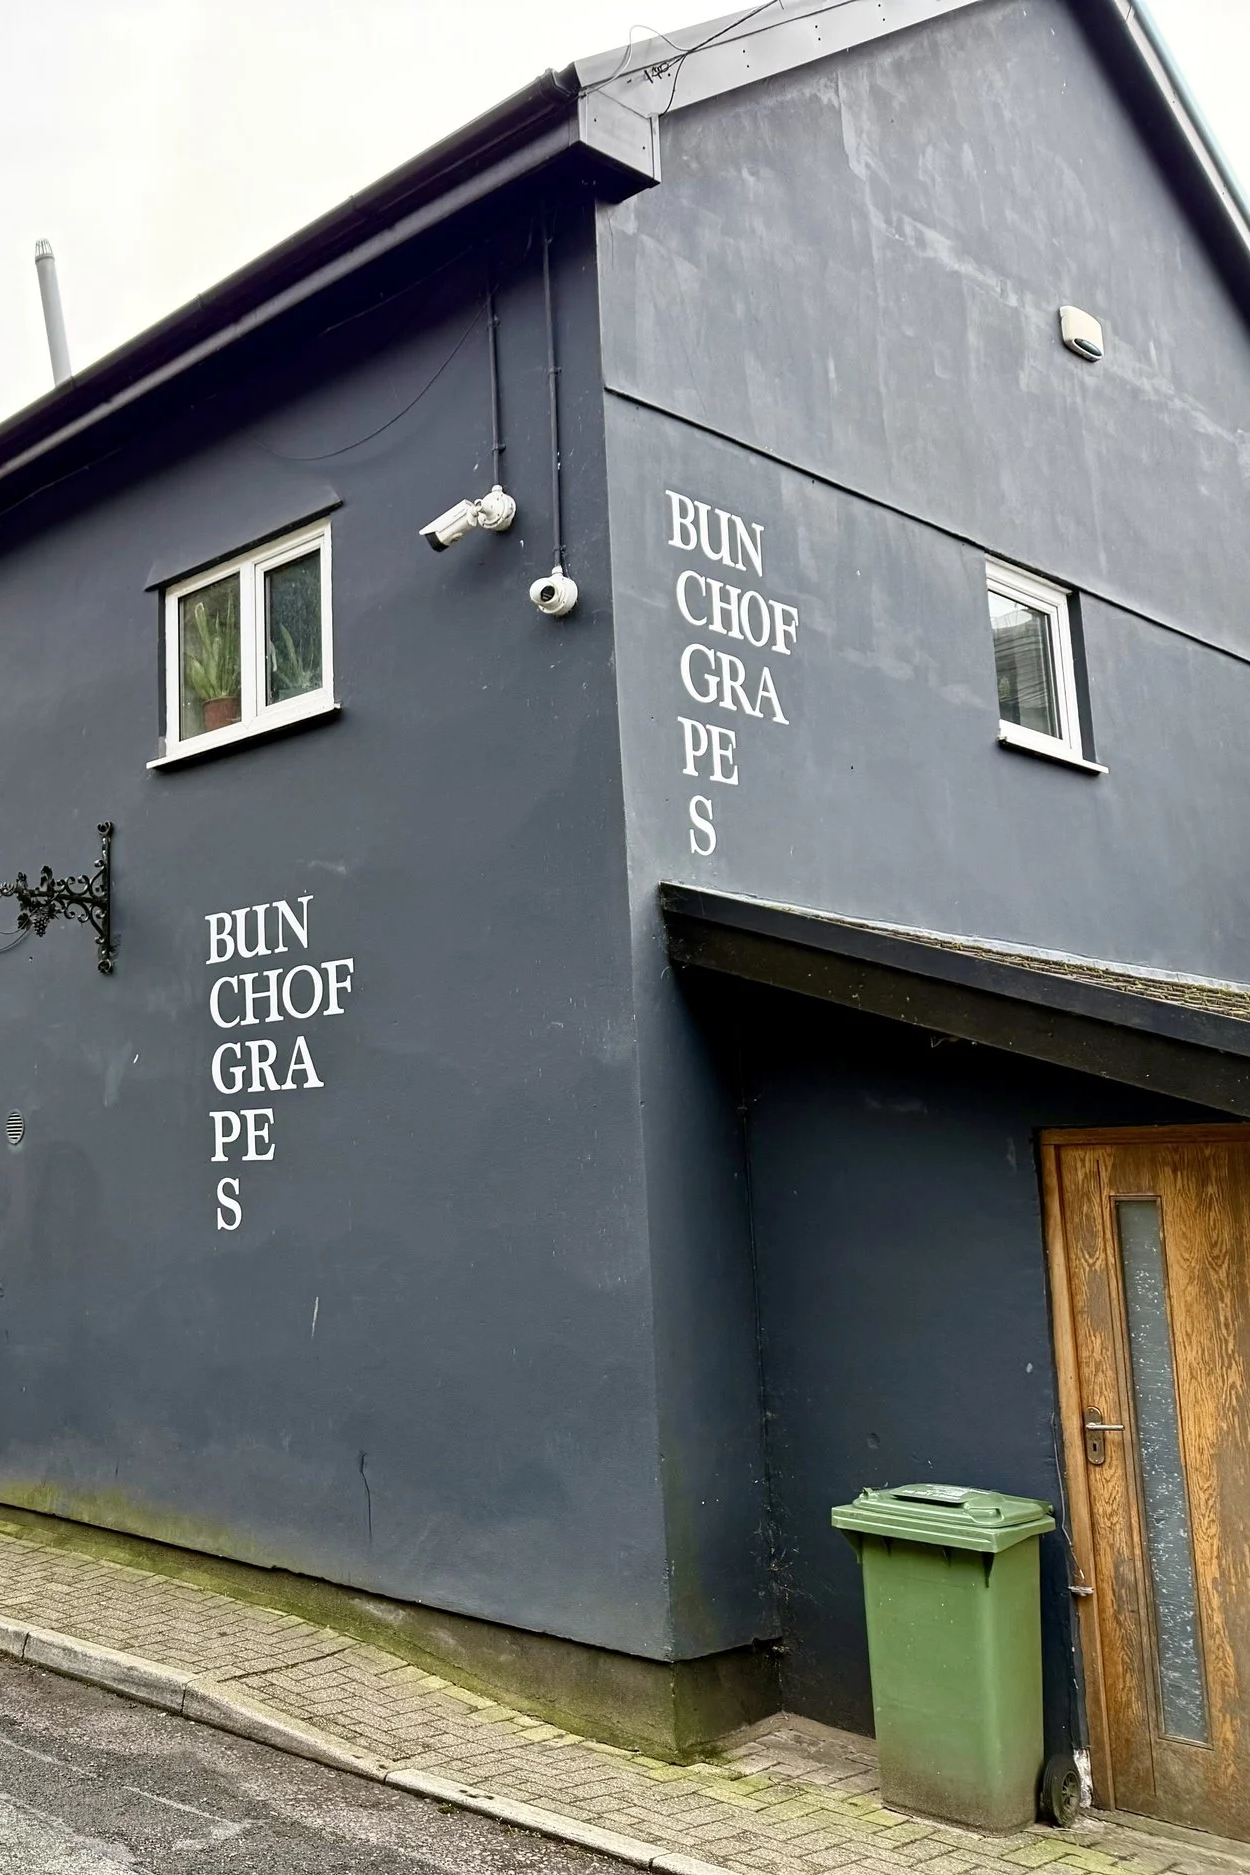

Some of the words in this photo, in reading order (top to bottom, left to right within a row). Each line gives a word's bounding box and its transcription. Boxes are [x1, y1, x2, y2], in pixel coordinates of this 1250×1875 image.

[665, 489, 765, 577] BUN
[676, 569, 799, 655] CHOF
[680, 643, 789, 725] GRA
[677, 716, 739, 786] PE
[689, 794, 717, 856] S
[205, 895, 313, 965] BUN
[209, 958, 354, 1029] CHOF
[211, 1035, 325, 1095] GRA
[209, 1108, 276, 1162] PE
[216, 1177, 242, 1231] S
